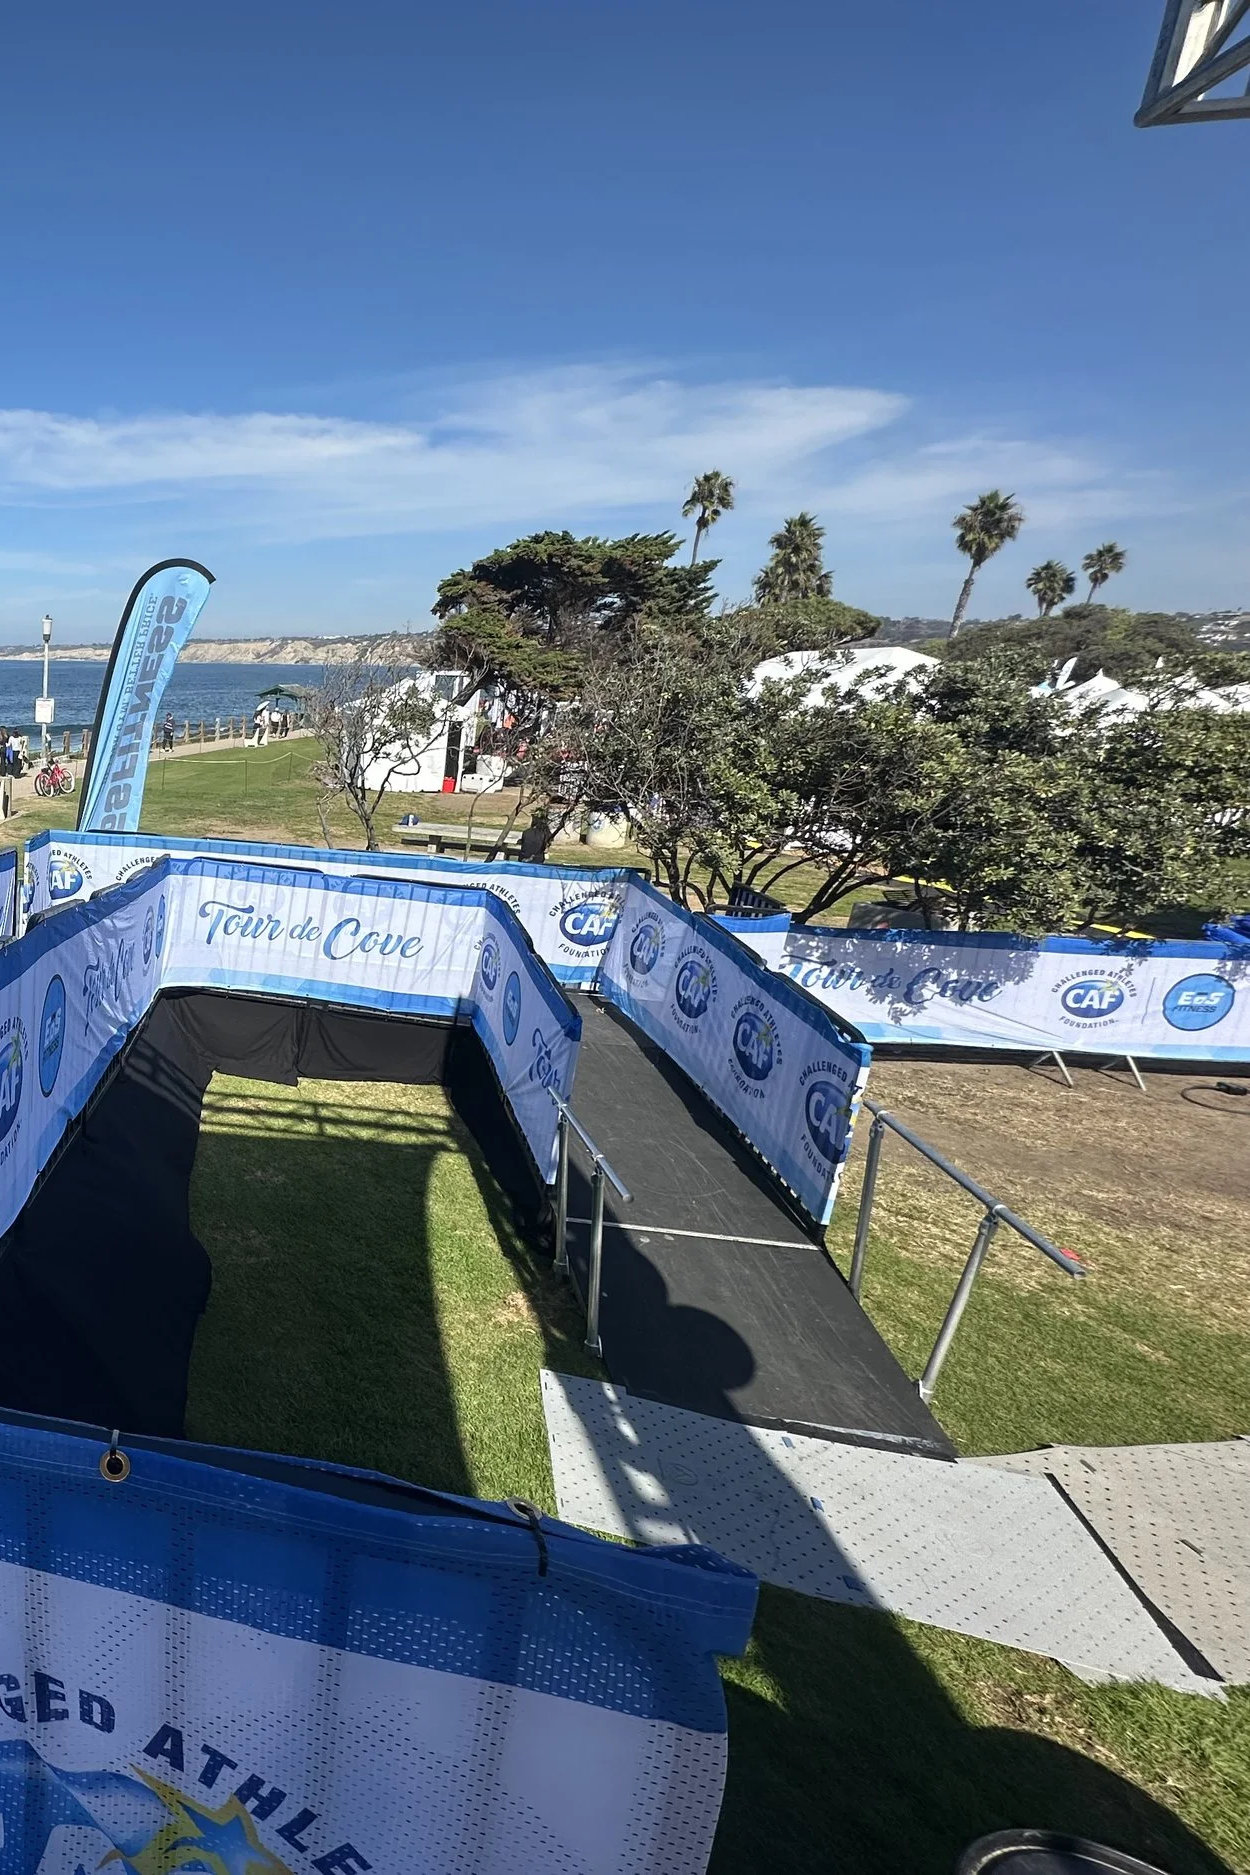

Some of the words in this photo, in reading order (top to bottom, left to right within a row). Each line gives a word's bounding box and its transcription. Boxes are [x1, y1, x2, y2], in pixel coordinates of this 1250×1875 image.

[63, 852, 93, 881] ATHLETES
[115, 856, 156, 881] CHALLENGE
[51, 870, 78, 890] AF
[488, 883, 521, 914] ATHLETES
[199, 900, 285, 945] Tour
[289, 916, 323, 942] de
[323, 917, 425, 961] Cove
[565, 912, 618, 936] CAF
[778, 954, 865, 991] Tour
[871, 967, 901, 989] de
[903, 967, 1003, 1005] Cove
[1051, 969, 1105, 994] CHALLENGED
[1065, 988, 1120, 1010] CAF
[1171, 1005, 1218, 1014] FITNESS
[1058, 1015, 1116, 1029] FOUNDATION
[799, 1060, 848, 1087] CHALLENGED
[141, 1722, 374, 1875] ATHLE
